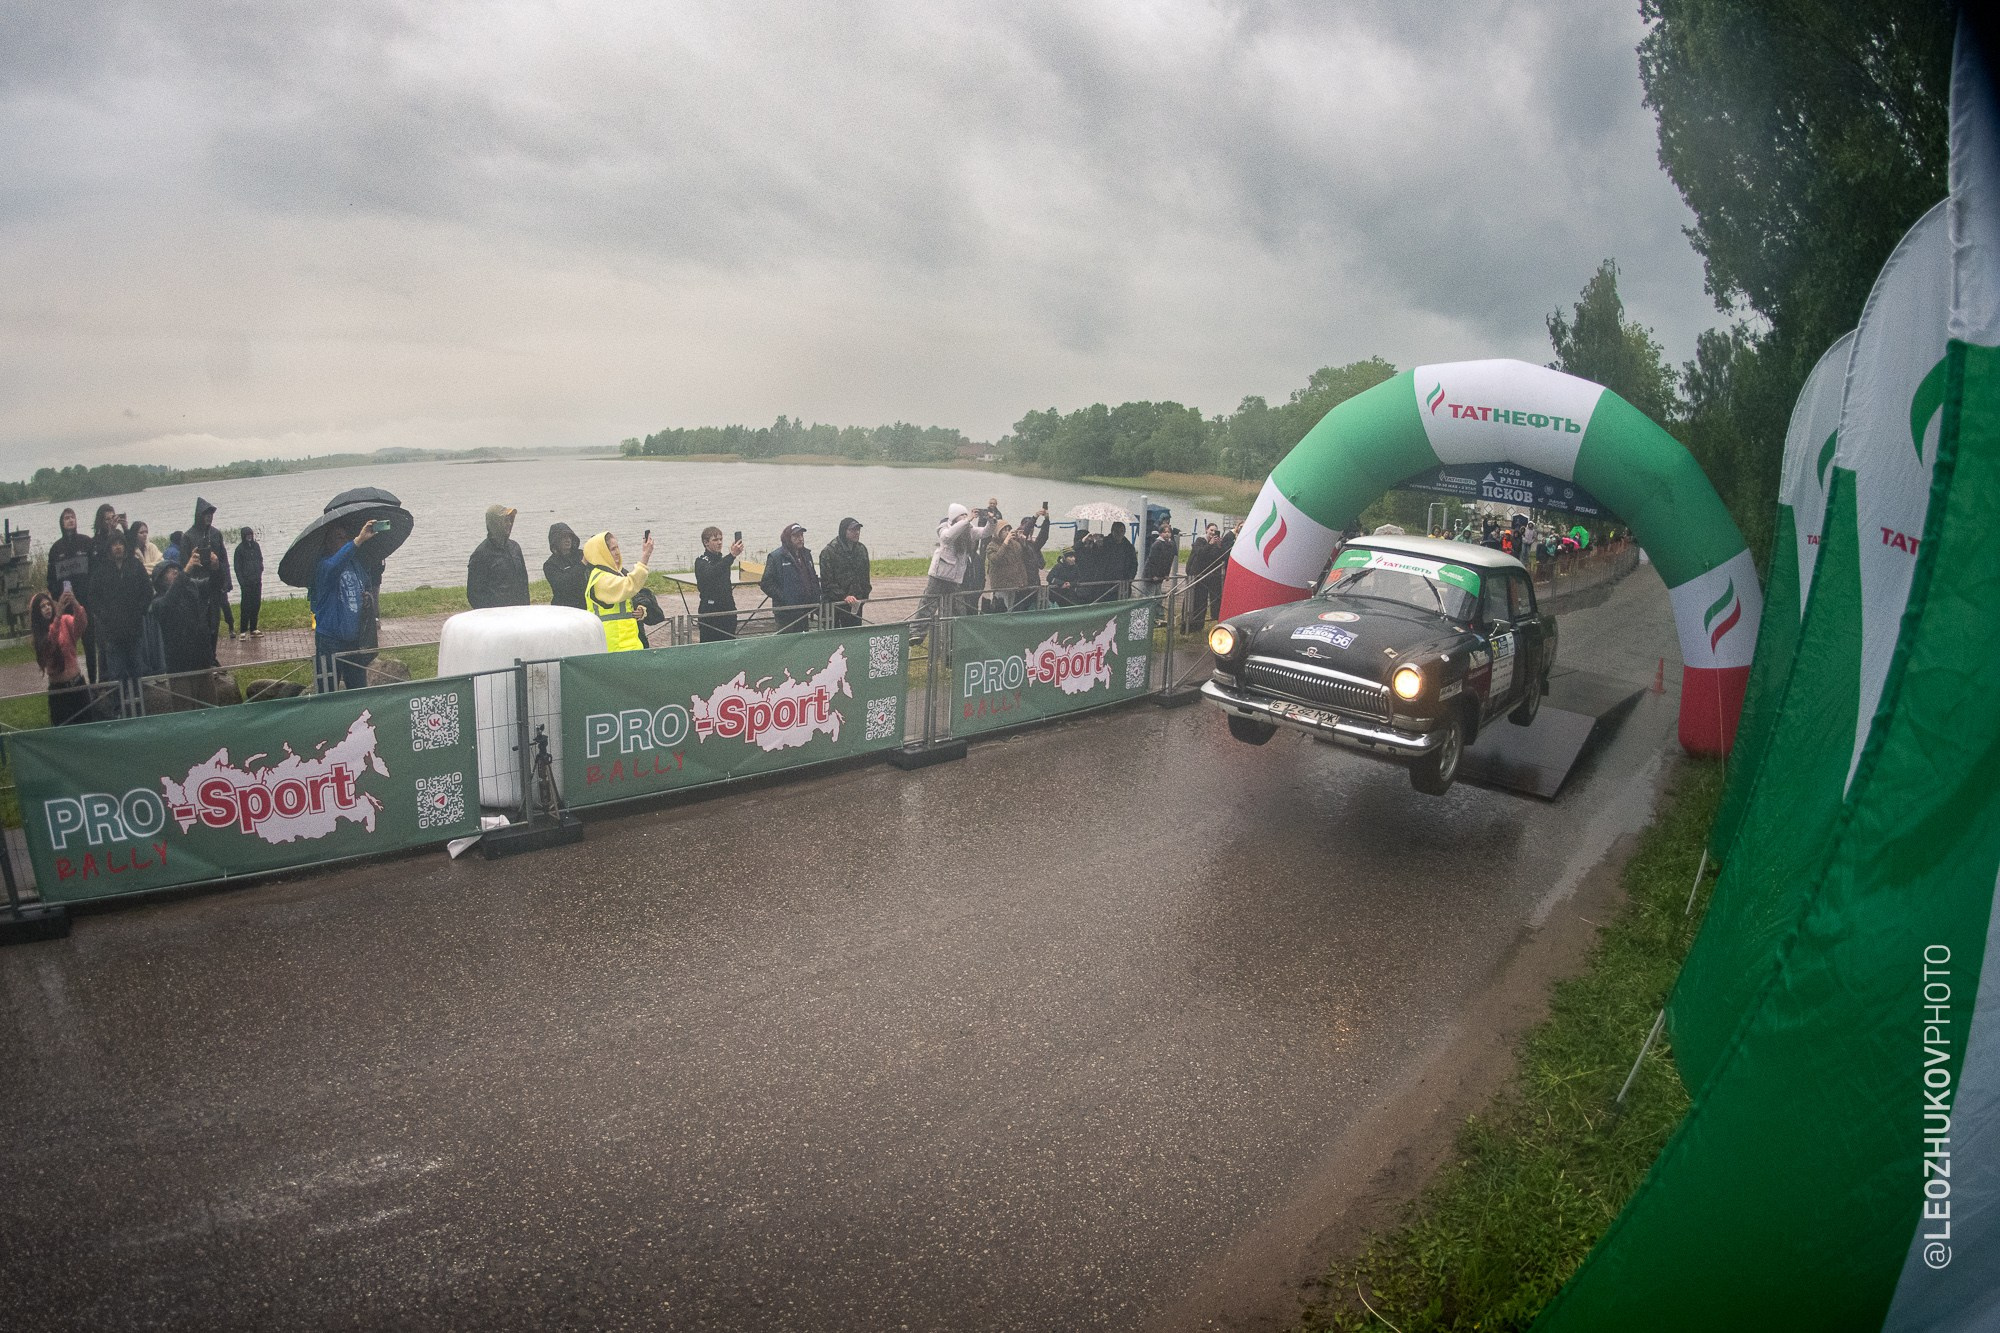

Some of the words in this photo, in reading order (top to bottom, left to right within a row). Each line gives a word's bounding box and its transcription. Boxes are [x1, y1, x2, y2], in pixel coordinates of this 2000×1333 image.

[1448, 404, 1581, 434] ТАТНЕФТЬ
[1498, 467, 1520, 477] 2026
[1500, 477, 1534, 488] РАЛЛИ
[1482, 485, 1533, 503] ПСКОВ
[1382, 560, 1432, 575] ТАТНЕФТЬ
[1332, 634, 1351, 647] 56
[586, 751, 686, 787] RALLY
[55, 840, 168, 881] RALLY
